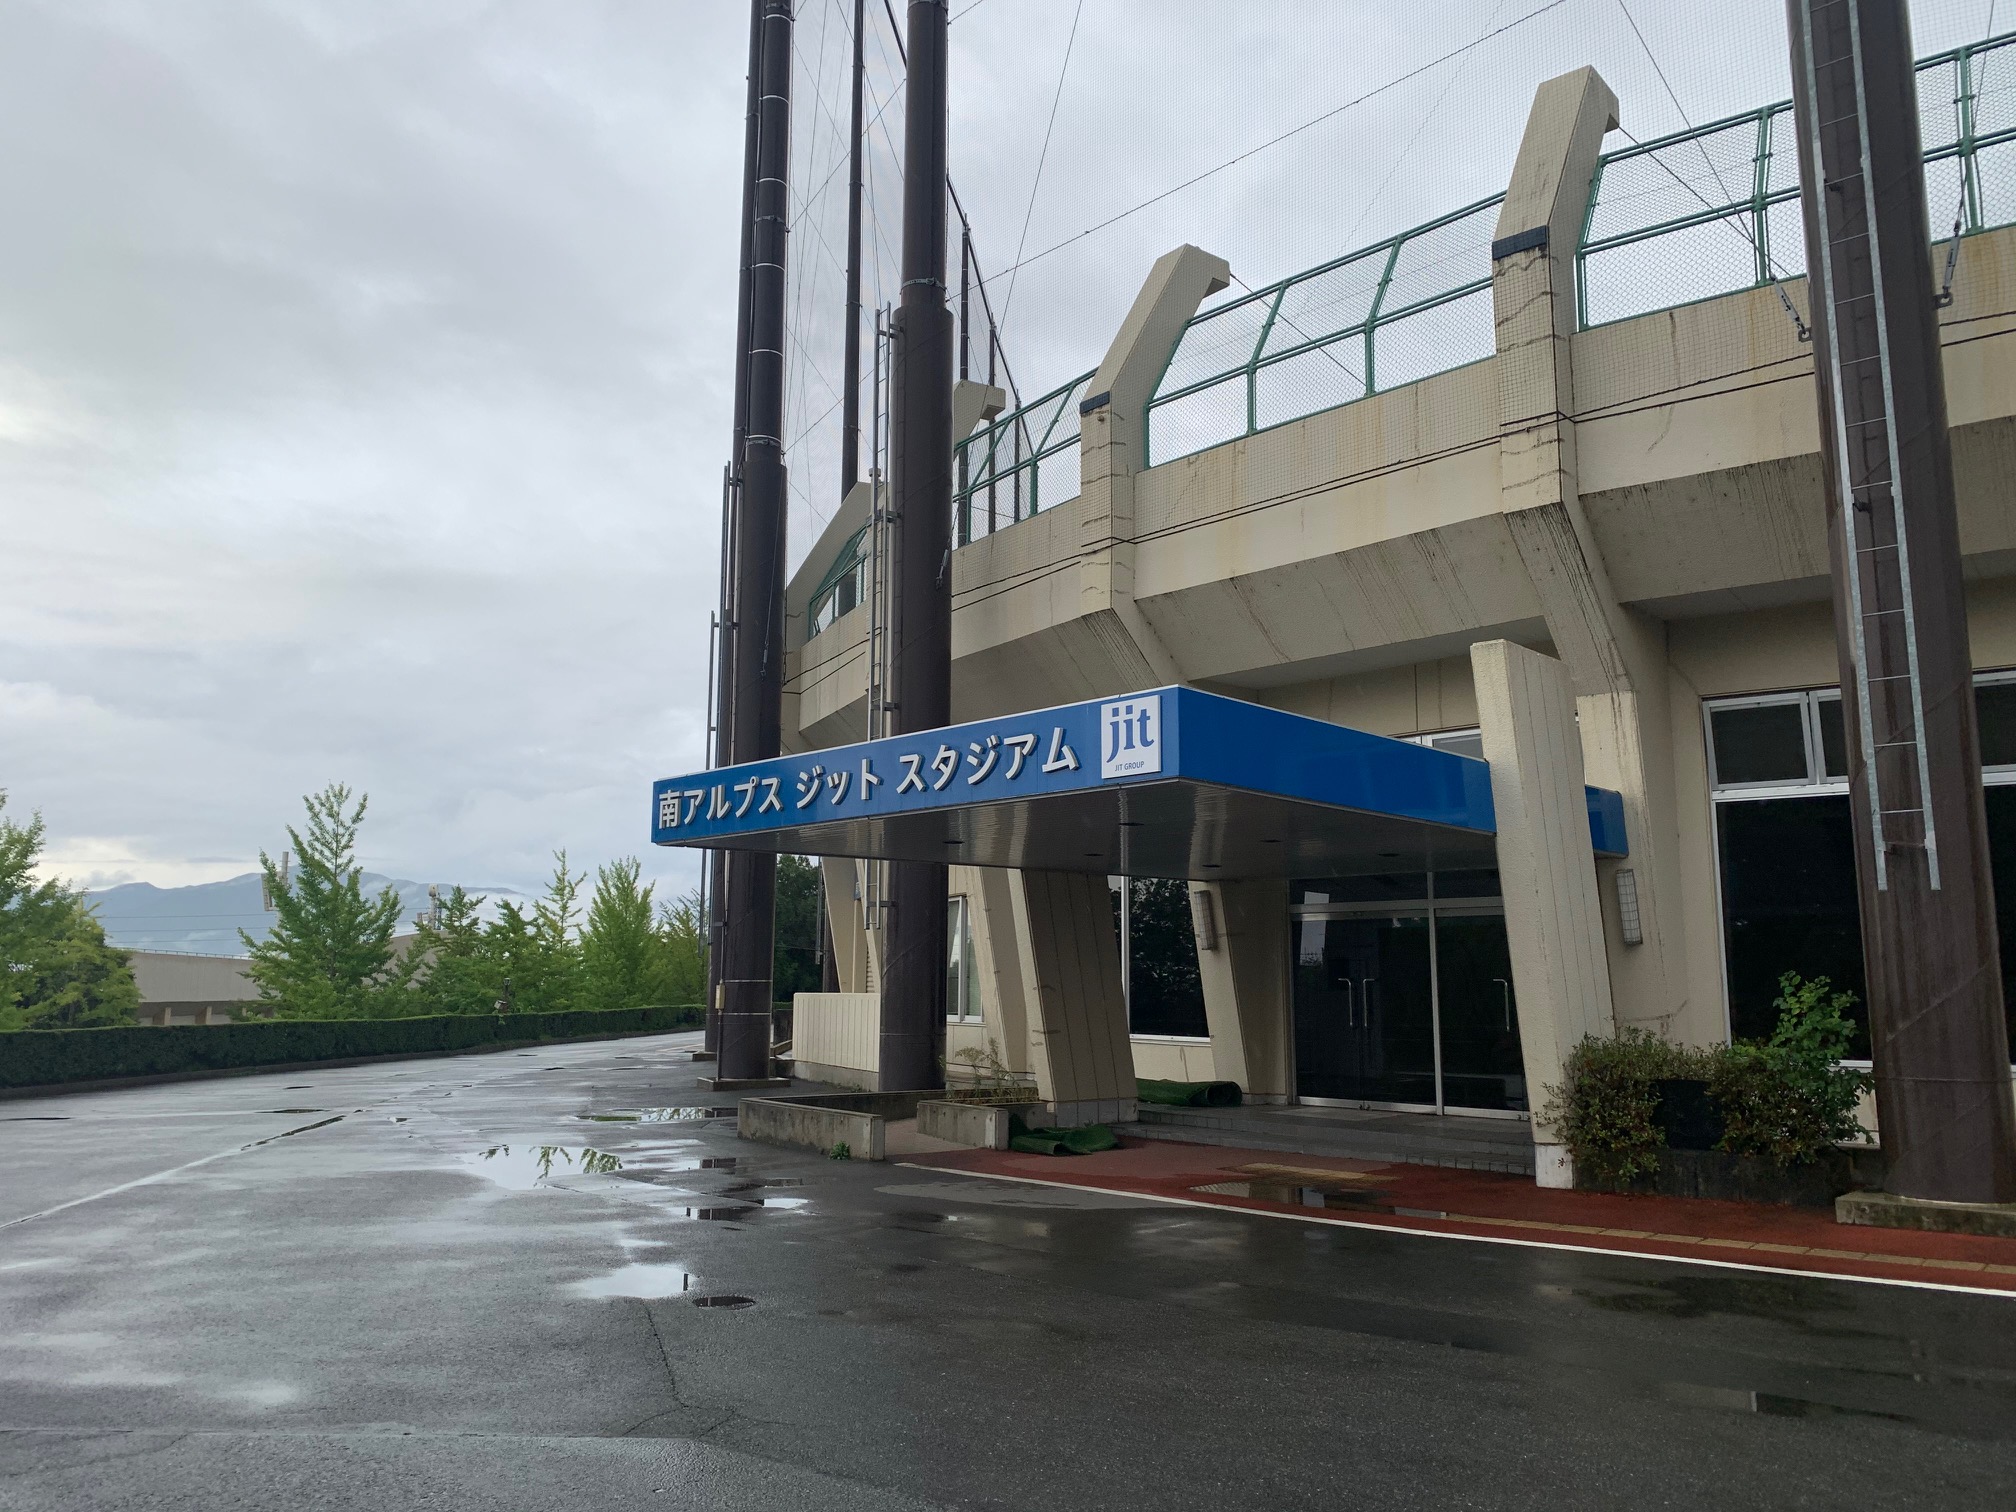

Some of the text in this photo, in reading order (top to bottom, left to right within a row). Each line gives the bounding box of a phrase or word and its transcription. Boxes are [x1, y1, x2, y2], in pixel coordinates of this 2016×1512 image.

[1106, 705, 1154, 763] jit
[658, 727, 1080, 829] 南アルプス ジット スタジアム
[1124, 761, 1145, 770] GROUP
